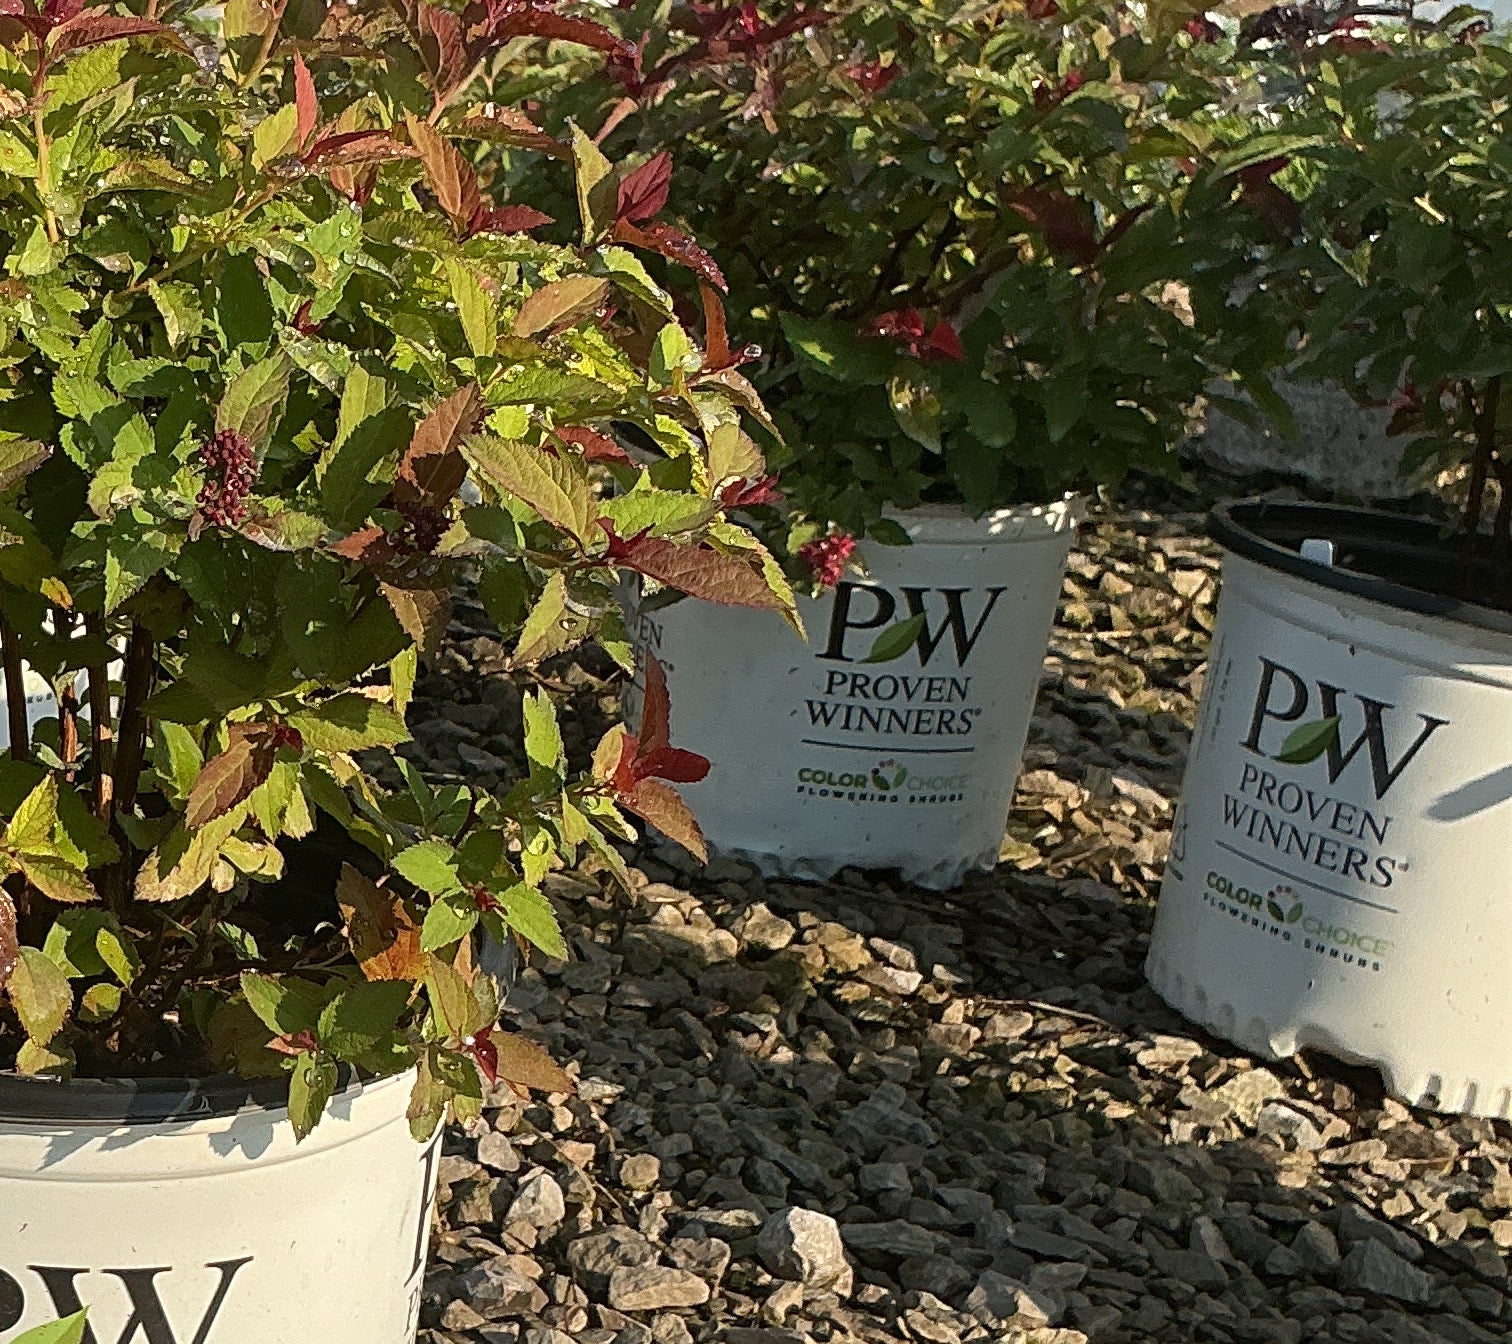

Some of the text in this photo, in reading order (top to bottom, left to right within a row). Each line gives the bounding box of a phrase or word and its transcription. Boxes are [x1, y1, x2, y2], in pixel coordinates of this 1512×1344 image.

[814, 581, 1008, 668] PW
[822, 670, 972, 703] PROVEN
[1239, 656, 1451, 800] PW
[797, 767, 967, 792] COLOR CHOICE
[1238, 762, 1393, 846] PROVEN
[1206, 871, 1388, 958] COLOR CHOICE
